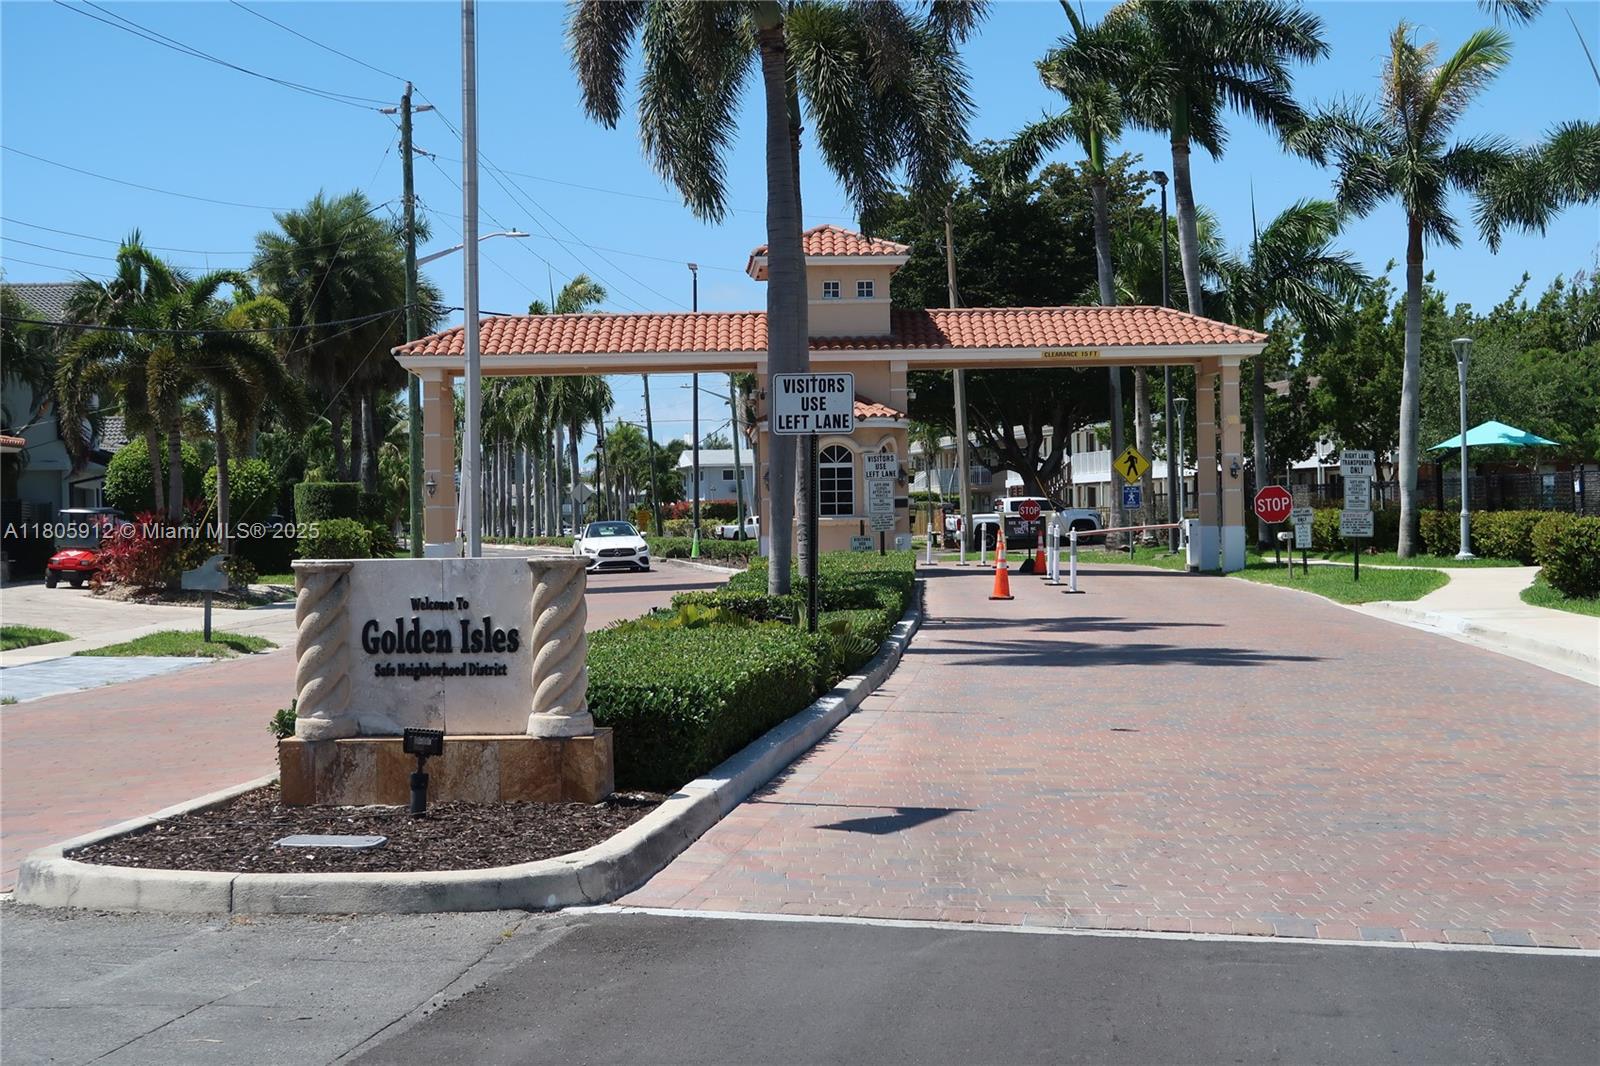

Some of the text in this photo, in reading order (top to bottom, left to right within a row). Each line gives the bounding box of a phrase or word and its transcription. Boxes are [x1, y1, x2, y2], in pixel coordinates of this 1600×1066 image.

[783, 378, 845, 394] VISITORS
[801, 396, 827, 412] USE
[778, 413, 850, 430] LEFT LANE
[867, 455, 895, 463] VISITORS
[1344, 452, 1370, 460] RIGHT LANE
[881, 470, 897, 478] LANE
[1350, 466, 1364, 474] ONLY
[1019, 506, 1040, 515] STOP
[1257, 496, 1290, 513] STOP
[410, 596, 470, 611] Welcome To
[361, 615, 520, 655] Golden Isles
[374, 662, 508, 681] Safe Neighborhood District
